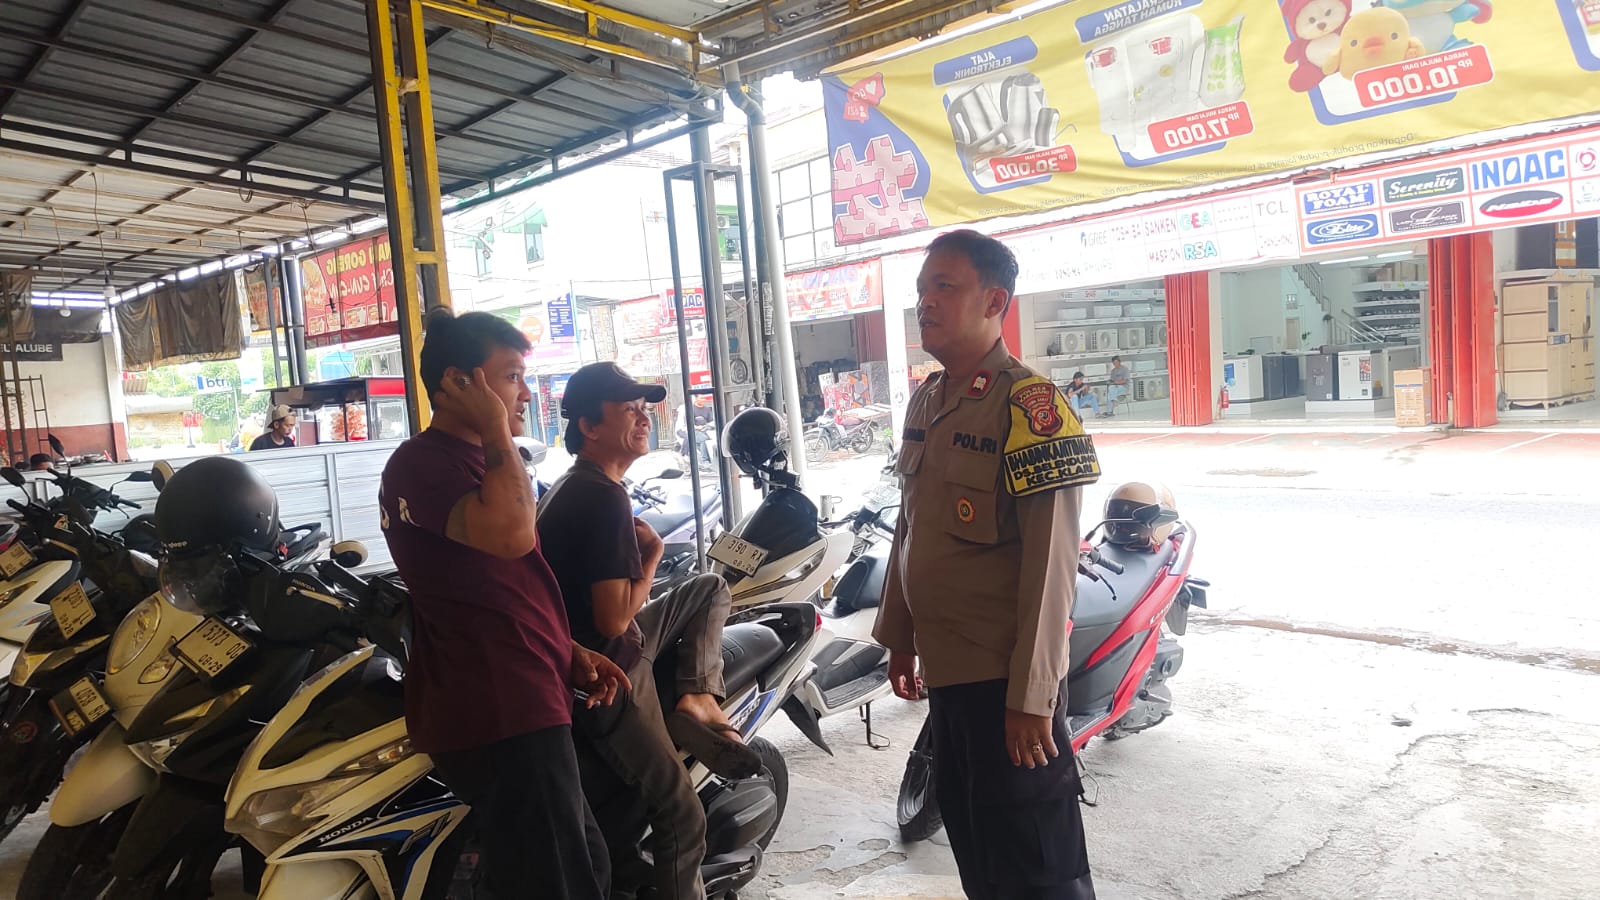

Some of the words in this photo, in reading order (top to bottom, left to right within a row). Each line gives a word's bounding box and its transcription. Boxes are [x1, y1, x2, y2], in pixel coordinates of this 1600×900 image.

[1472, 149, 1565, 190] INOAC
[1306, 183, 1368, 200] ROYAL
[1389, 176, 1459, 196] Serenity
[1256, 200, 1289, 217] TCL
[1313, 194, 1366, 210] FOAM
[1145, 218, 1177, 235] SANKEN
[1183, 241, 1218, 261] RSA
[952, 432, 997, 455] POLRI
[202, 623, 230, 647] 5373
[318, 815, 373, 843] HONDA
